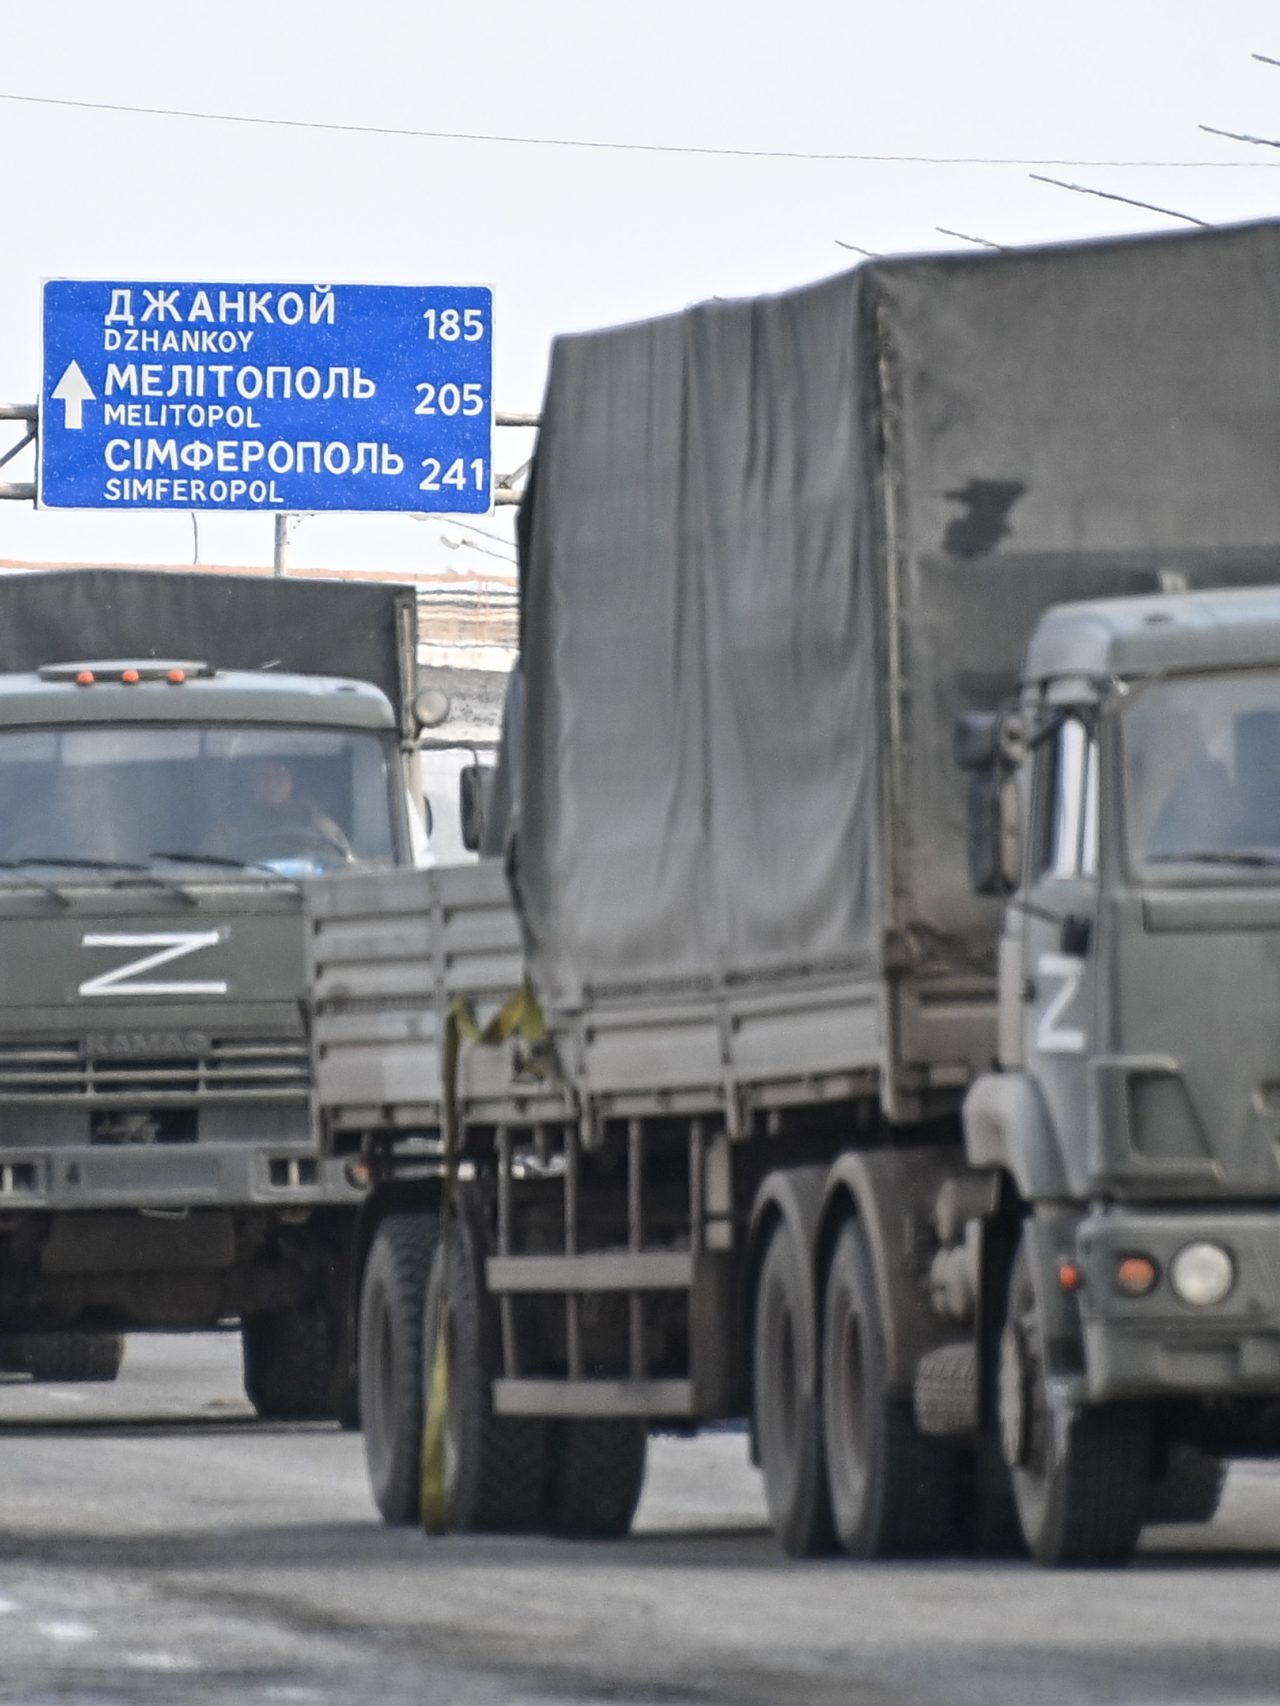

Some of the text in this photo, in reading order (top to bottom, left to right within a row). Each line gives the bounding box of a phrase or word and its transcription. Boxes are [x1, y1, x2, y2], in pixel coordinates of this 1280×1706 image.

[105, 284, 335, 325] ДЖАНКОЙ
[105, 329, 254, 352] DZHANKOY
[423, 309, 484, 341] 185
[104, 363, 376, 399] МЕЛІТОПОЛЬ
[105, 404, 260, 428] MELITOPOL
[415, 383, 483, 416] 205
[105, 439, 404, 475] СІМФЕРОПОЛЬ
[105, 479, 284, 502] SIMFEROPOL
[420, 458, 483, 490] 241
[78, 931, 228, 996] Z
[1037, 955, 1084, 1052] Z
